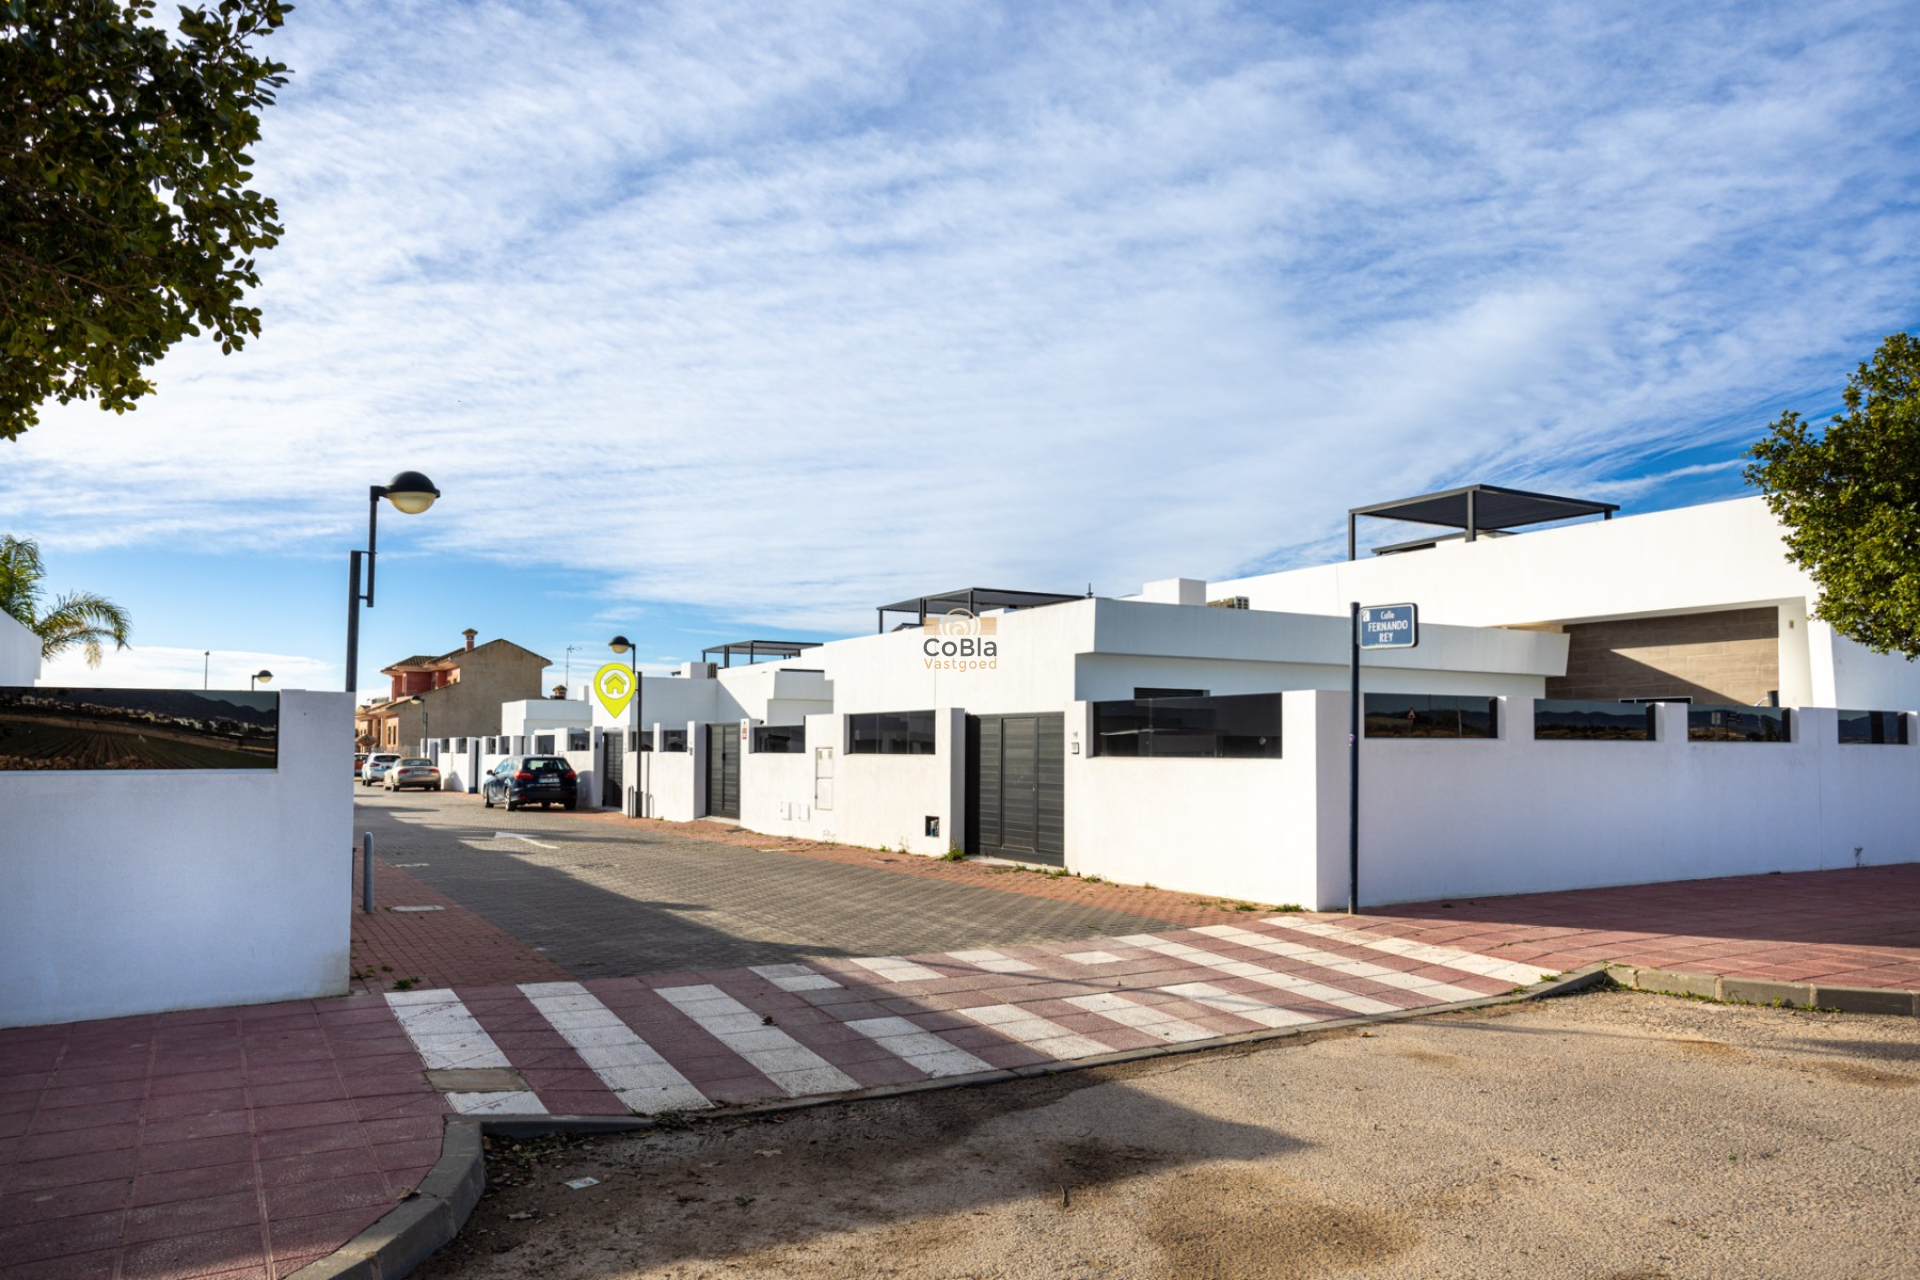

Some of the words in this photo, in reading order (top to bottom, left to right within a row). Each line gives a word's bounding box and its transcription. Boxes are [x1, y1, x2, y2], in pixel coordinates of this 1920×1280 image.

[1380, 611, 1395, 620] Calle
[1368, 620, 1408, 632] FERNANDO
[1379, 632, 1394, 643] REY
